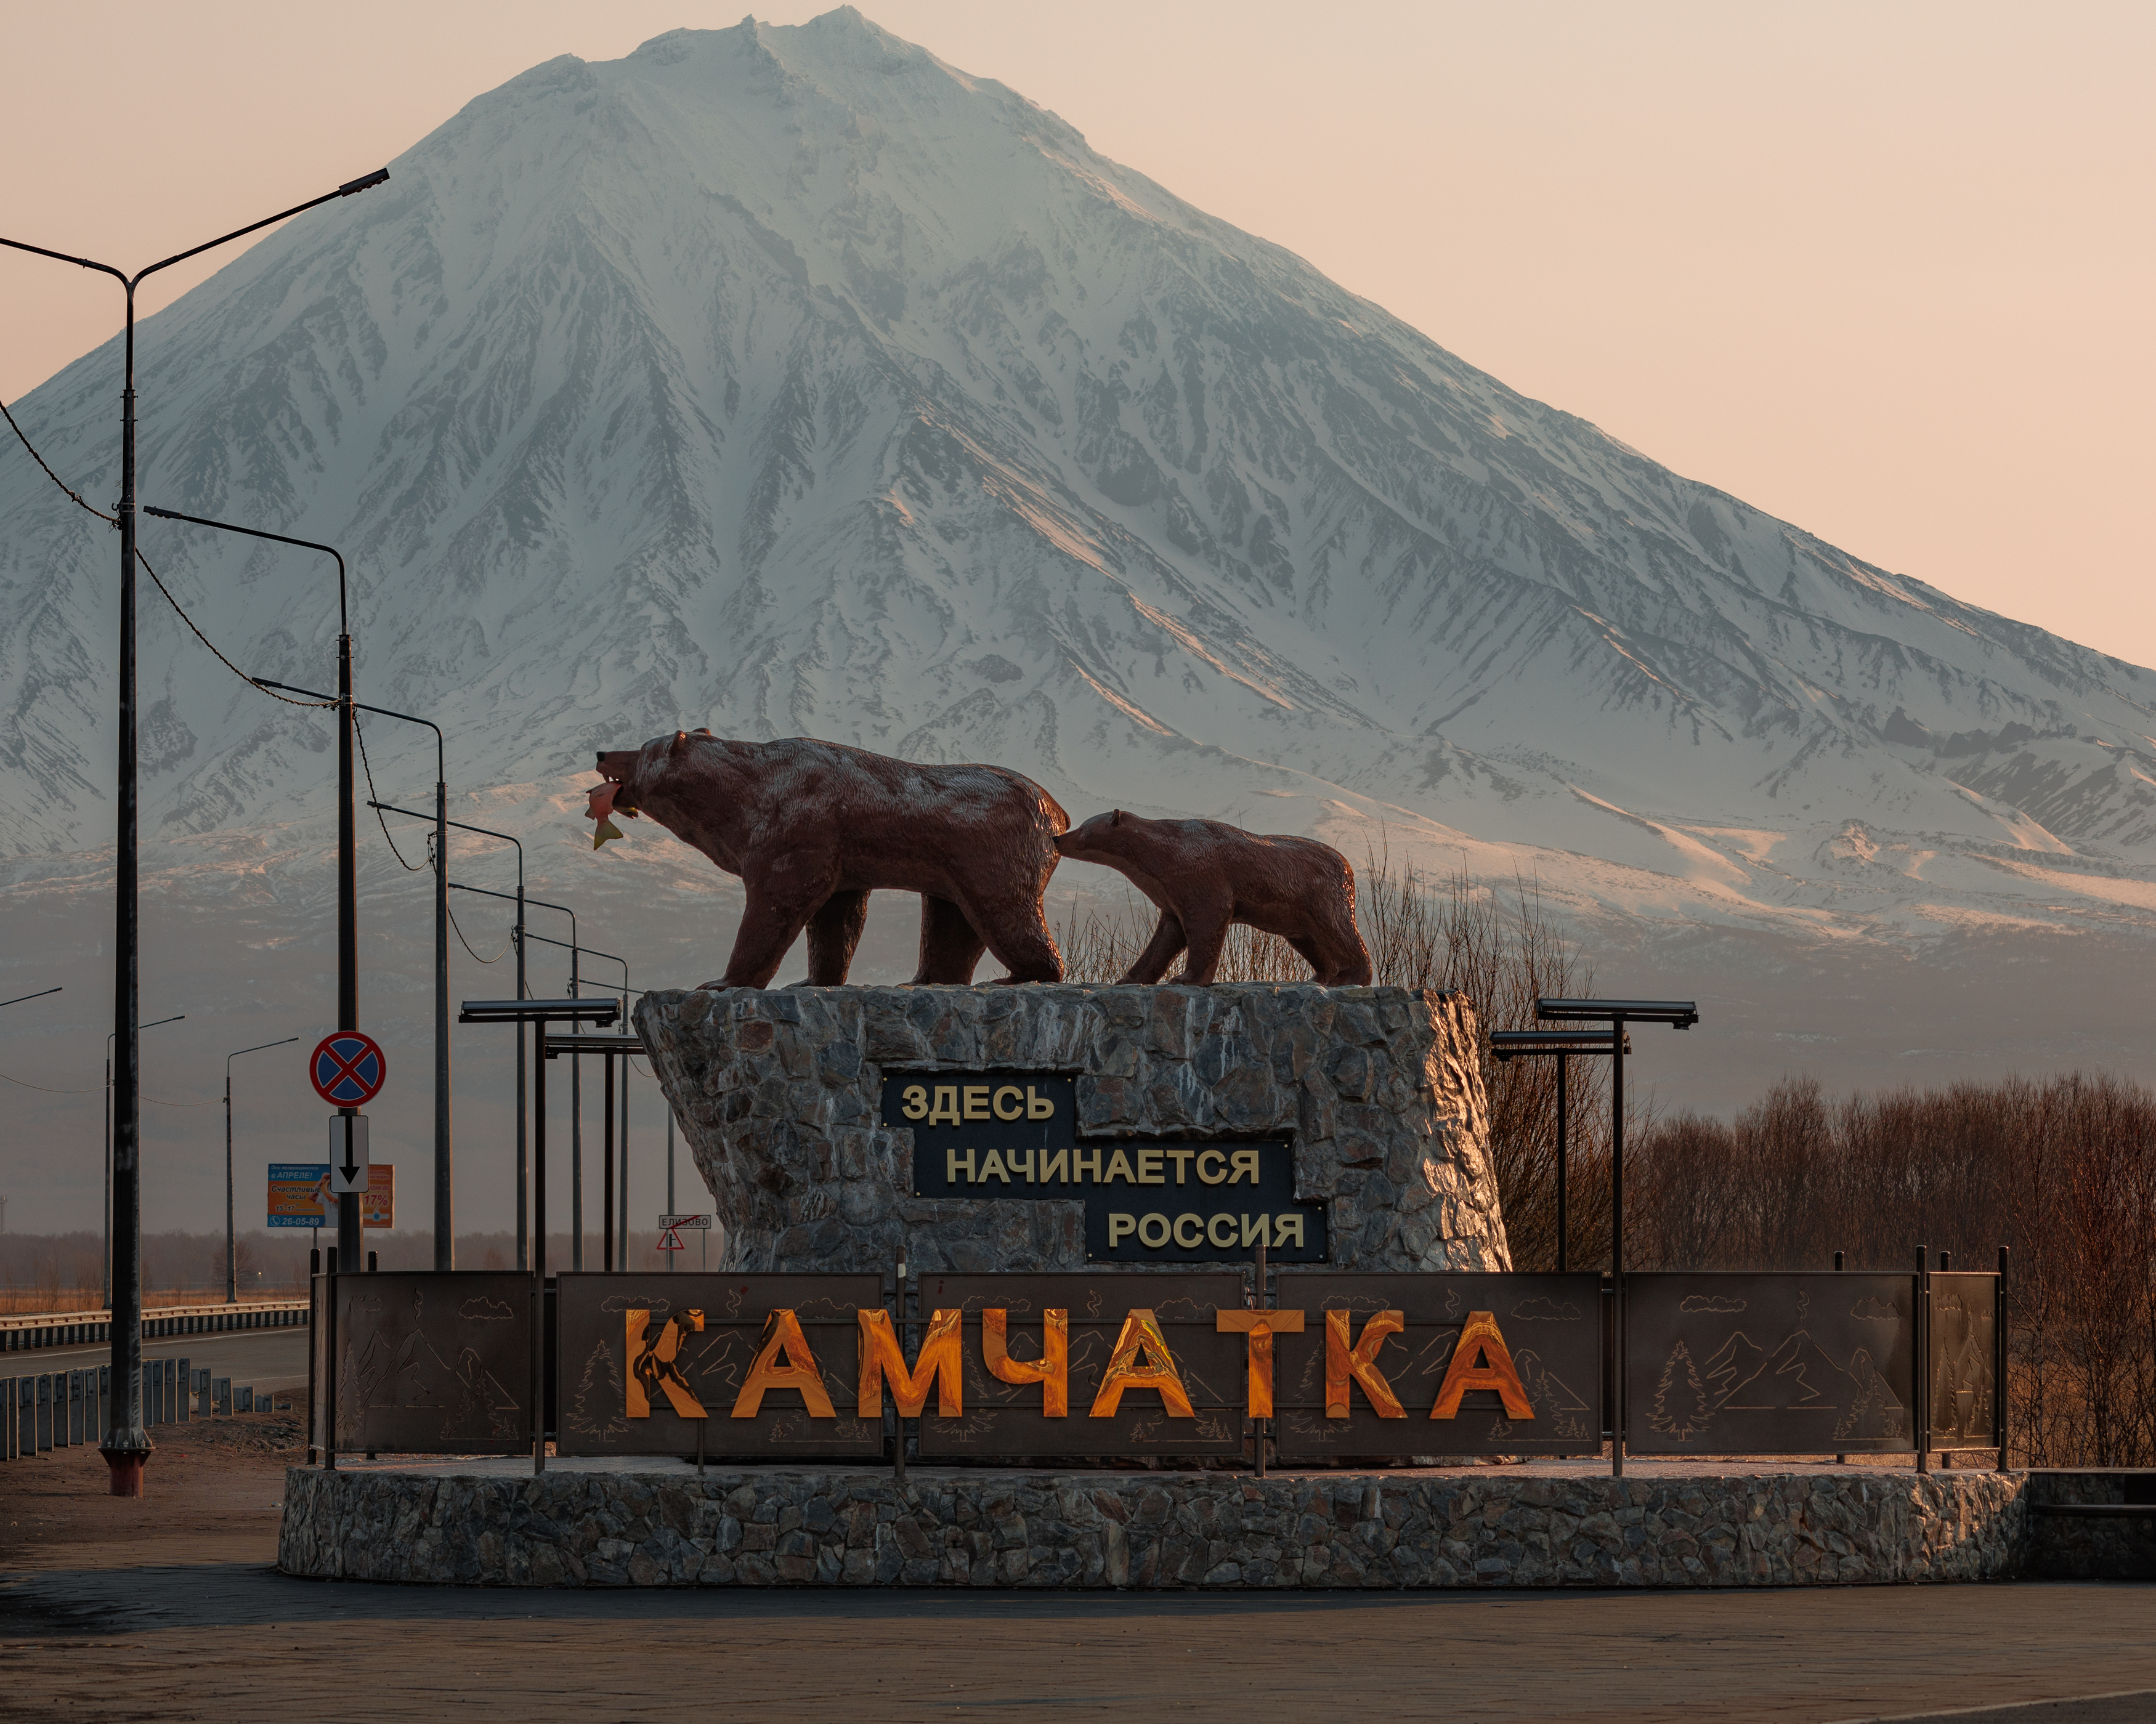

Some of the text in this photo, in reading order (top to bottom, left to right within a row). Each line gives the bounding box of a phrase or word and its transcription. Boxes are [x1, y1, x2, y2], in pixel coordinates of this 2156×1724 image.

[902, 1085, 1055, 1127] ЗДЕСЬ
[946, 1148, 1259, 1184] НАЧИНАЕТСЯ
[271, 1185, 322, 1193] Счастливые
[364, 1194, 388, 1206] 17%
[282, 1217, 320, 1226] 26-05-89
[1109, 1212, 1304, 1248] РОССИЯ
[625, 1308, 1536, 1420] КАМЧАТКА
